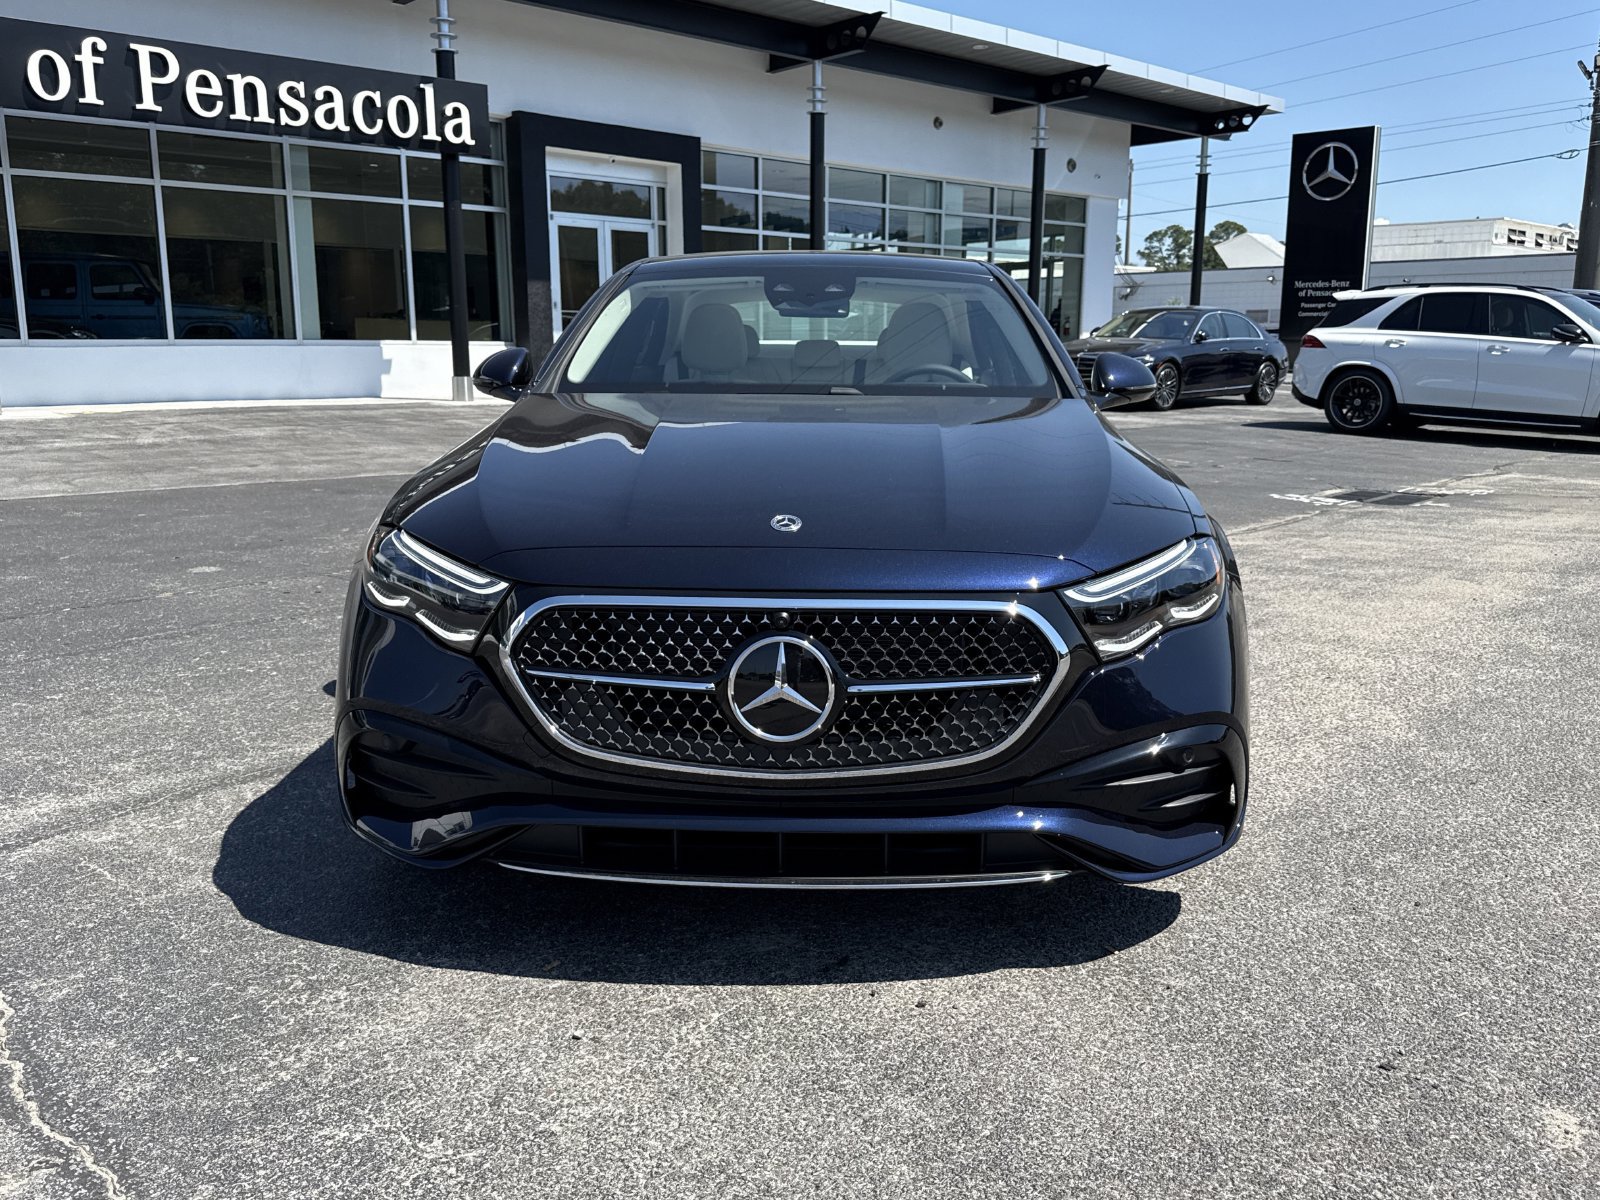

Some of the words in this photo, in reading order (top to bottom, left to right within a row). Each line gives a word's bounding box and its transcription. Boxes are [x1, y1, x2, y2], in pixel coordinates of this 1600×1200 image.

[26, 36, 108, 106] of
[129, 43, 476, 146] Pensacola
[1294, 279, 1350, 289] Mercedes-Benz
[1298, 289, 1306, 297] of
[1307, 289, 1340, 297] Pensac
